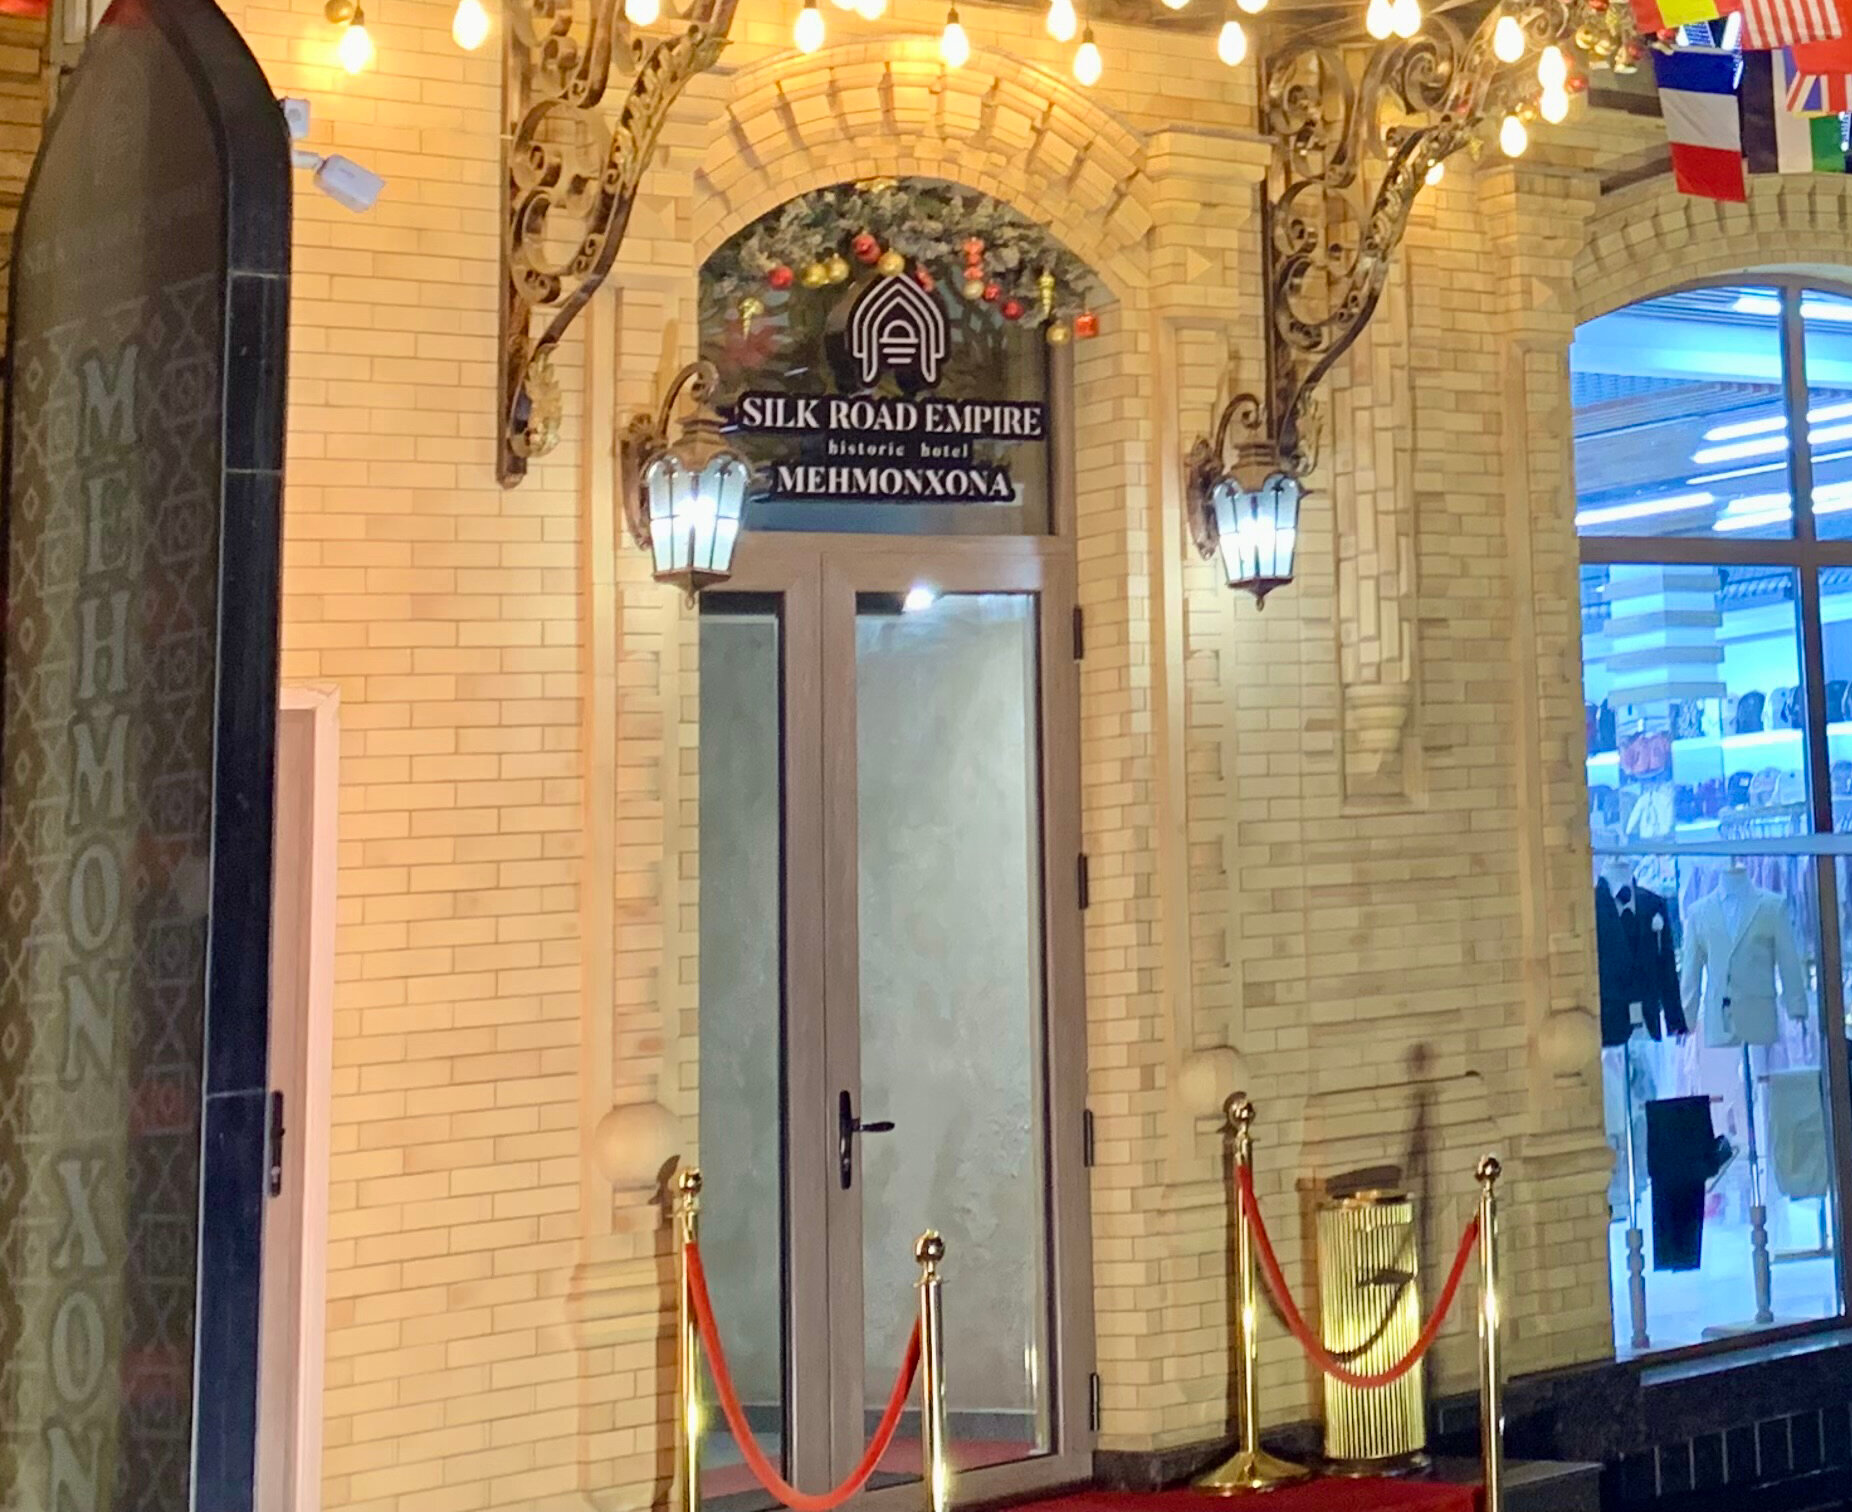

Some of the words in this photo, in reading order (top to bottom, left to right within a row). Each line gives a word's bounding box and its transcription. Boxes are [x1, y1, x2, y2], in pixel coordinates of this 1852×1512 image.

[742, 397, 820, 429] SILK
[829, 399, 918, 431] ROAD
[925, 403, 1042, 436] EMPIRE
[828, 439, 905, 456] historic
[920, 442, 969, 458] hotel
[777, 465, 1010, 497] MEHMONXONA
